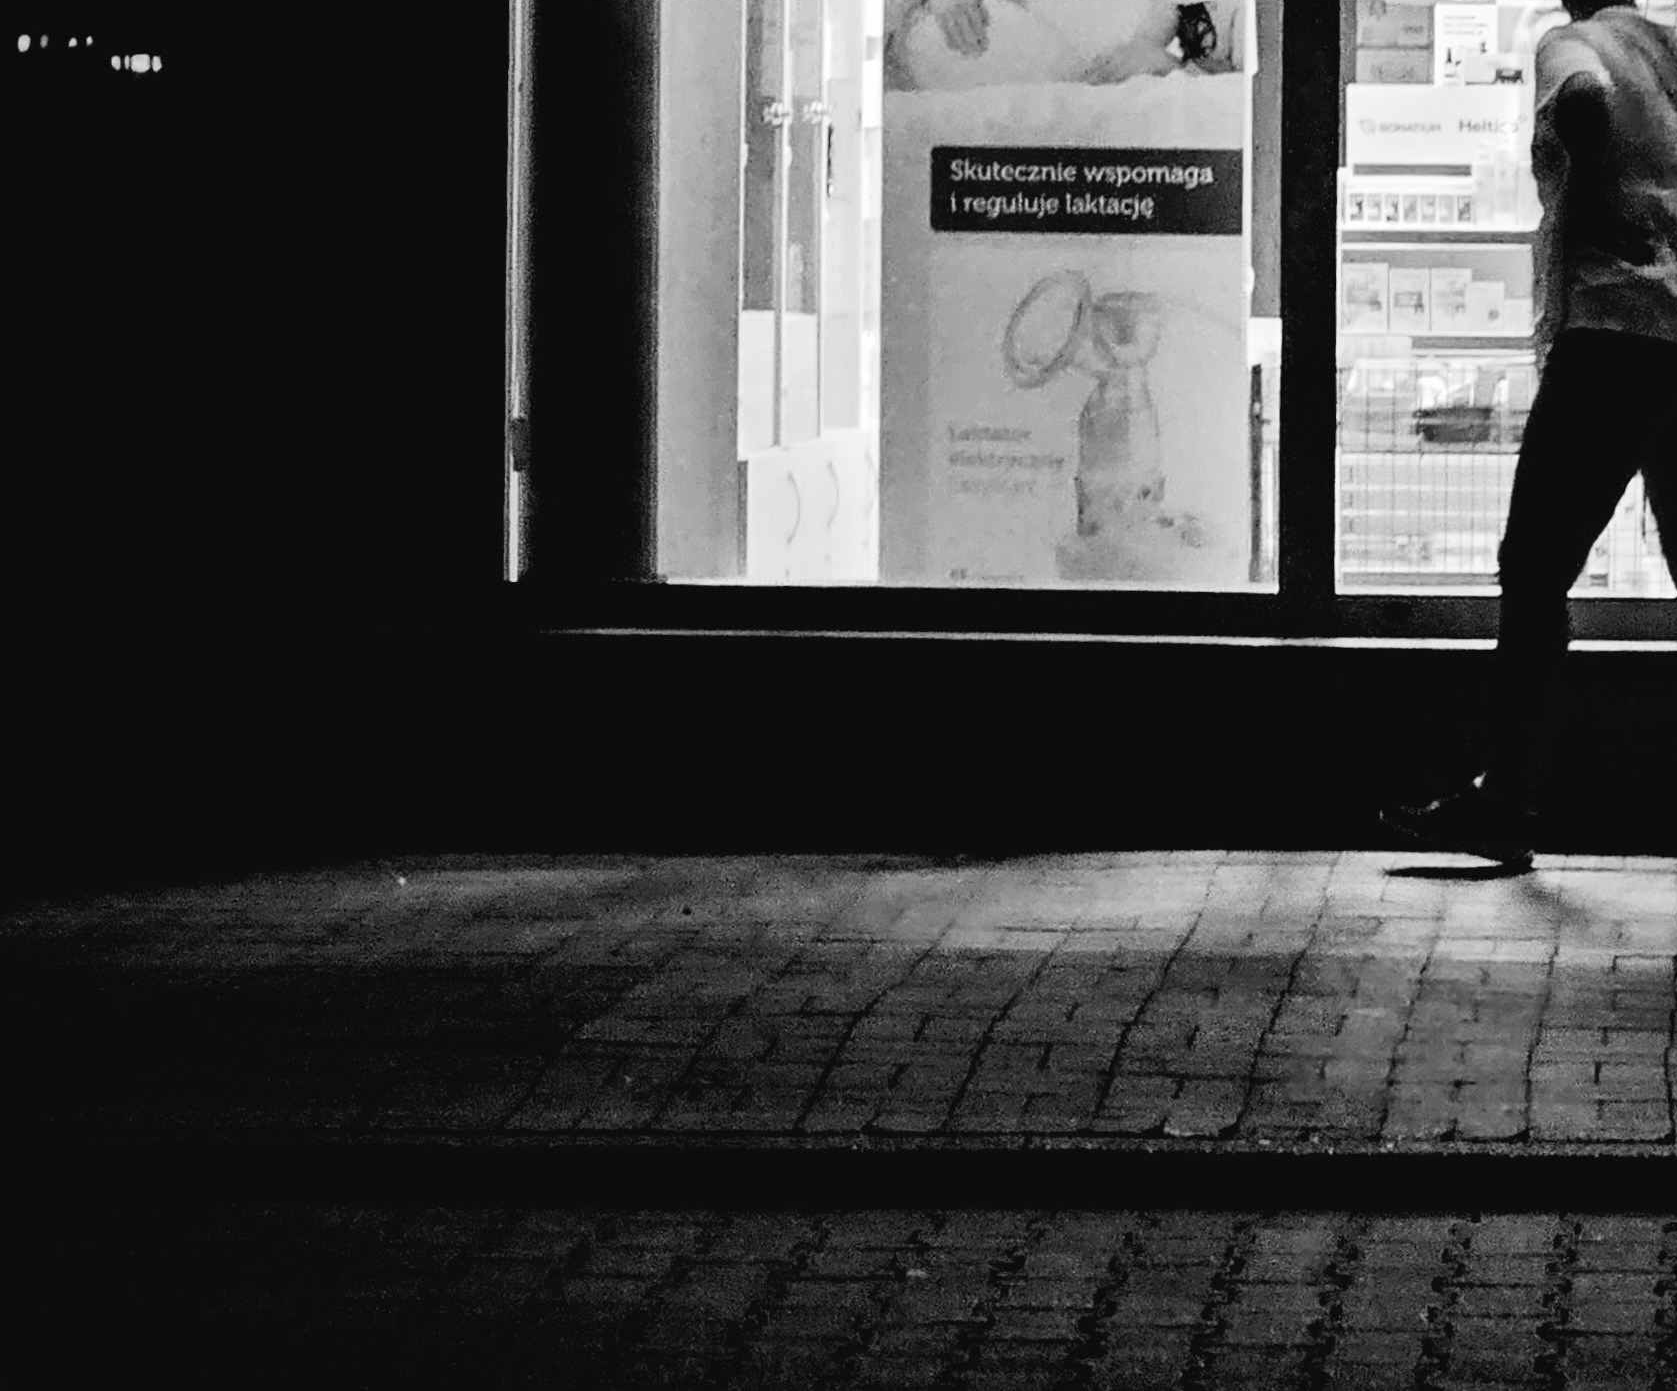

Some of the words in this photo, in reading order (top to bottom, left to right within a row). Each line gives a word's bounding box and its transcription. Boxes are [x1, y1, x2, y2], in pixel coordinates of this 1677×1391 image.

[949, 158, 1078, 182] Skutecznie
[1083, 165, 1215, 190] wspomaga
[950, 191, 957, 214] i
[963, 192, 1060, 218] reguluje
[1065, 192, 1156, 220] laktację
